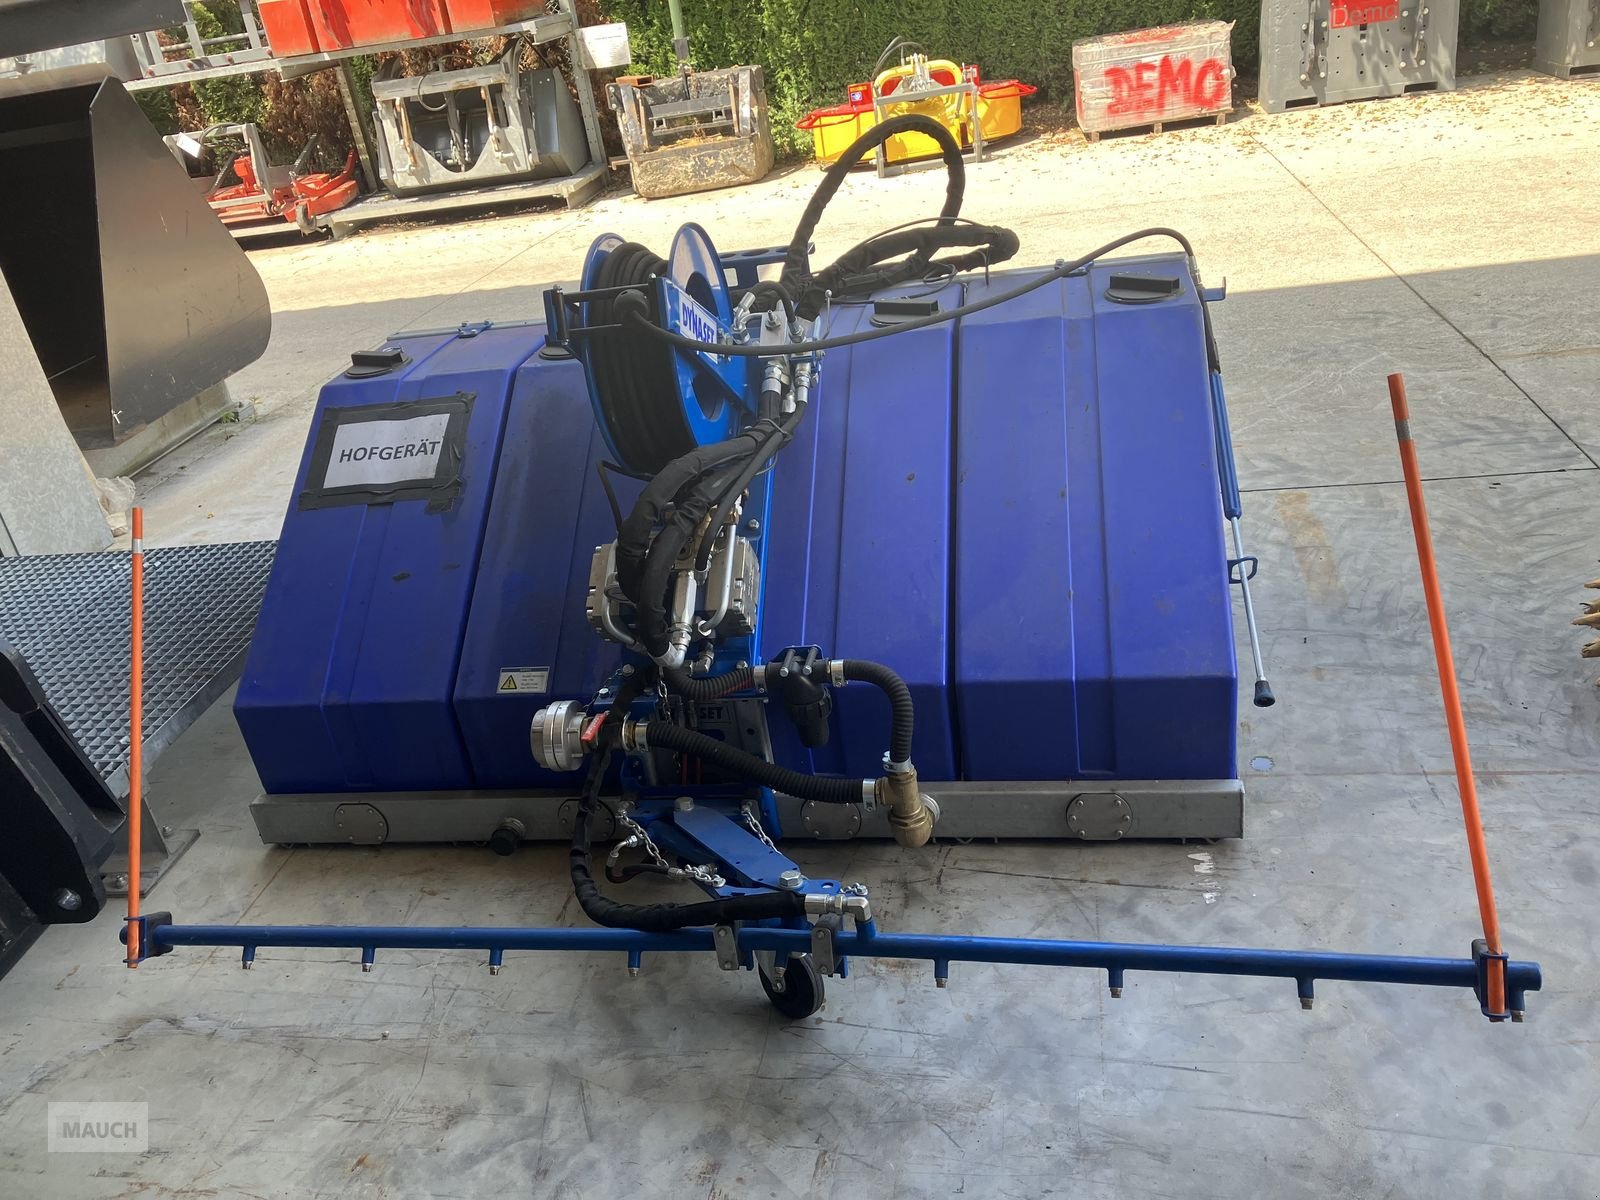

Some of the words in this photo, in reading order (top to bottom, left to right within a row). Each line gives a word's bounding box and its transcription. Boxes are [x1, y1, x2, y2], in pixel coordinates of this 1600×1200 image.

[1332, 5, 1397, 27] Demo
[1104, 54, 1226, 118] DEMO
[682, 302, 715, 343] DYNASET
[339, 439, 440, 463] HOFGERÄT
